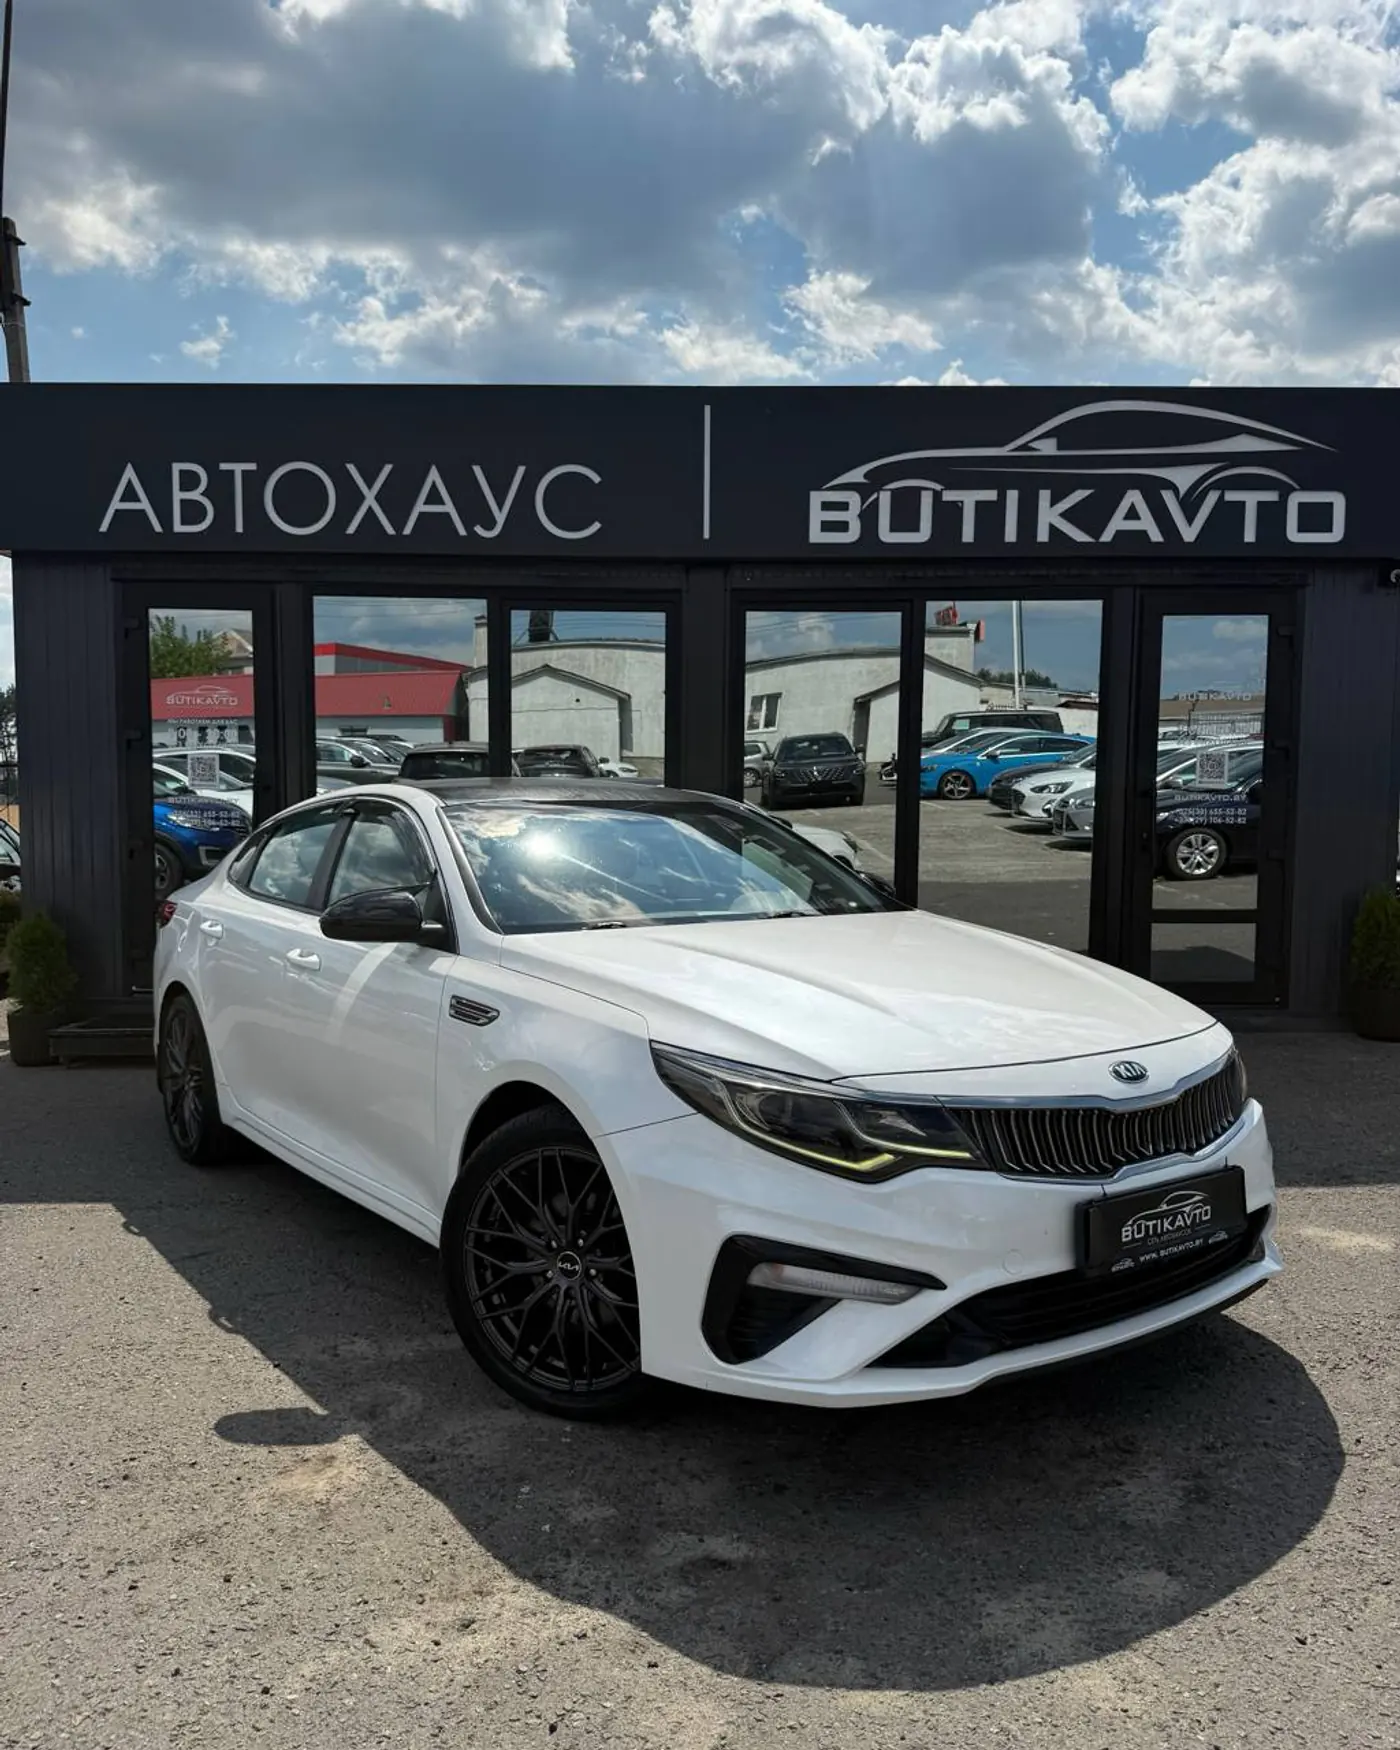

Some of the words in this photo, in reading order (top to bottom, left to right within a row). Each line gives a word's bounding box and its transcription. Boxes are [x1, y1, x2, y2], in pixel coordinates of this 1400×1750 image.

[99, 461, 602, 539] АВТОХАУС
[809, 489, 1346, 544] BUTIKAVTO
[166, 695, 239, 706] BUTIKAVTO
[1114, 1062, 1147, 1079] KIA
[1121, 1205, 1211, 1242] BUTIKAVTO
